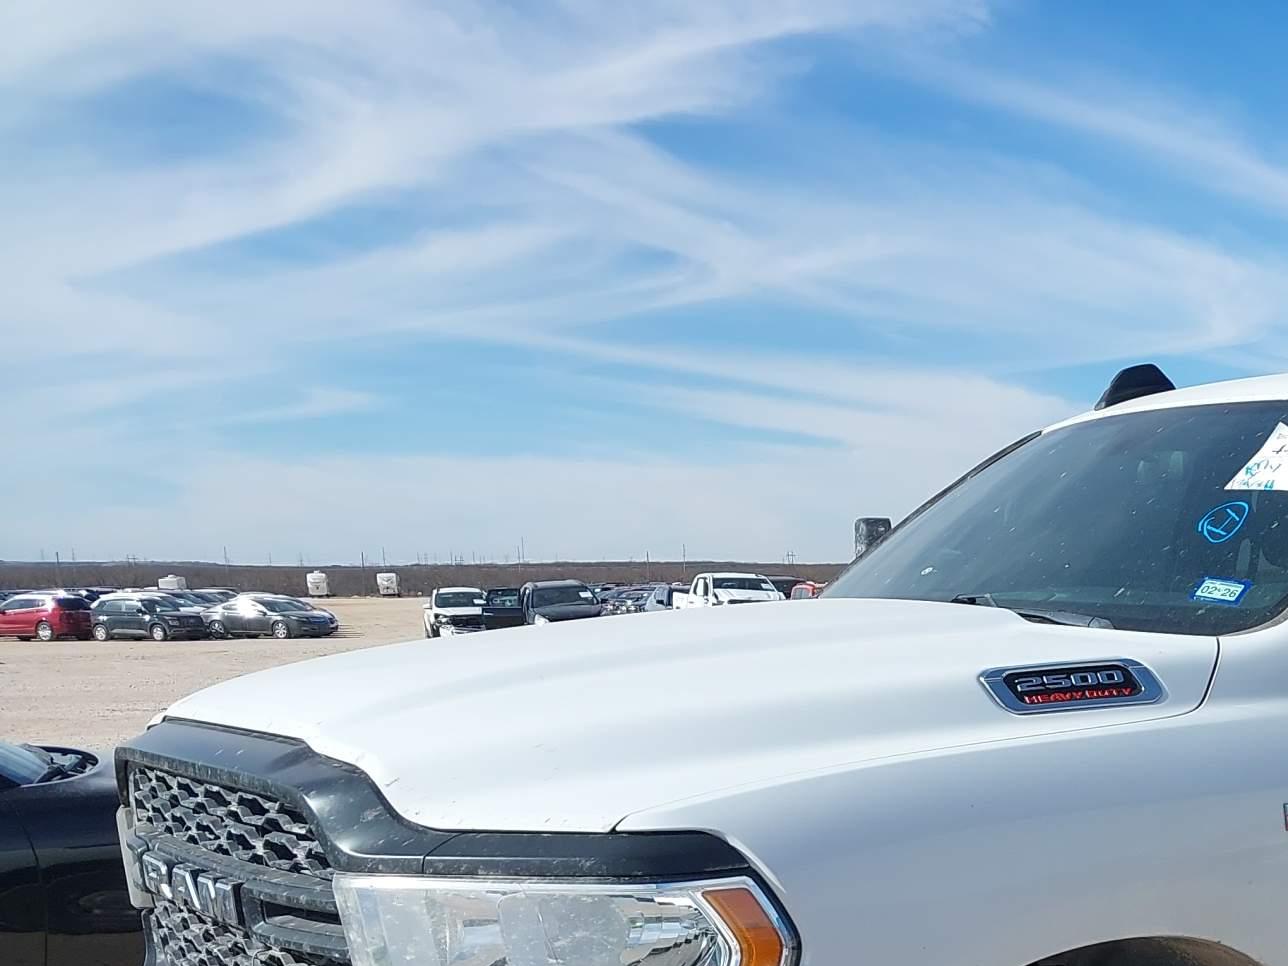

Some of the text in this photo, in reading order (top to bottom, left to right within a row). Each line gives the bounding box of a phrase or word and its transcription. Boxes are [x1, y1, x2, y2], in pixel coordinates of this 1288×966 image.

[1200, 585, 1239, 598] 02 26
[1015, 669, 1125, 692] 2500
[1023, 687, 1134, 704] HEAVY DUTY
